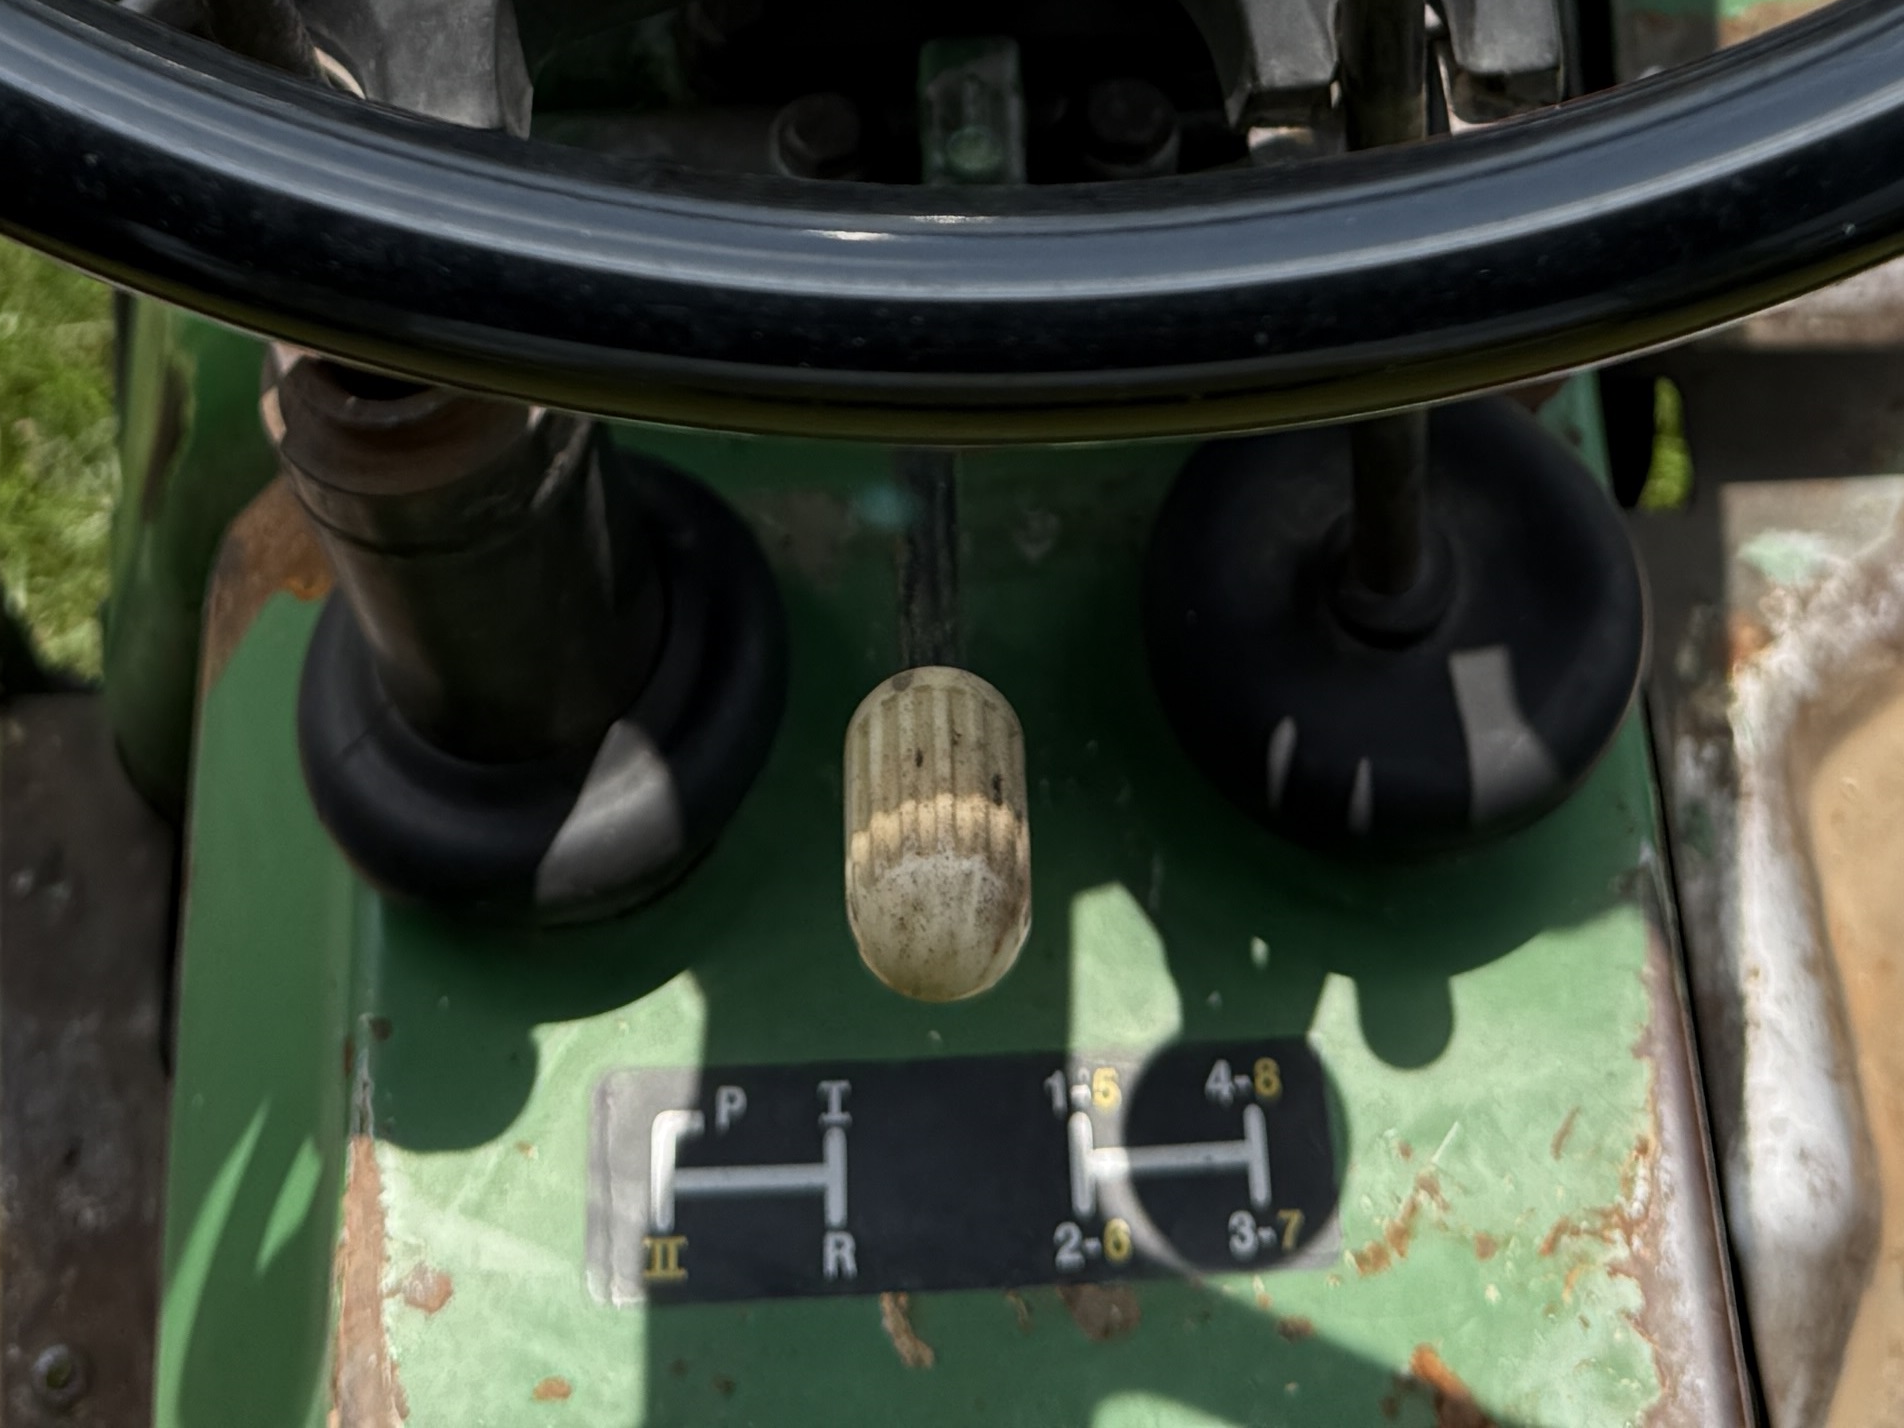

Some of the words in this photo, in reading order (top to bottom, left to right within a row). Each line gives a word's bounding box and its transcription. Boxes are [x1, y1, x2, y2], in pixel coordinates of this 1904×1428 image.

[1044, 1066, 1123, 1113] 1-5
[1204, 1056, 1283, 1107] 4-8
[715, 1084, 748, 1132] P
[642, 1235, 689, 1280] II
[822, 1230, 858, 1279] R
[1053, 1217, 1133, 1272] 2-6
[1227, 1208, 1305, 1261] 3-7
